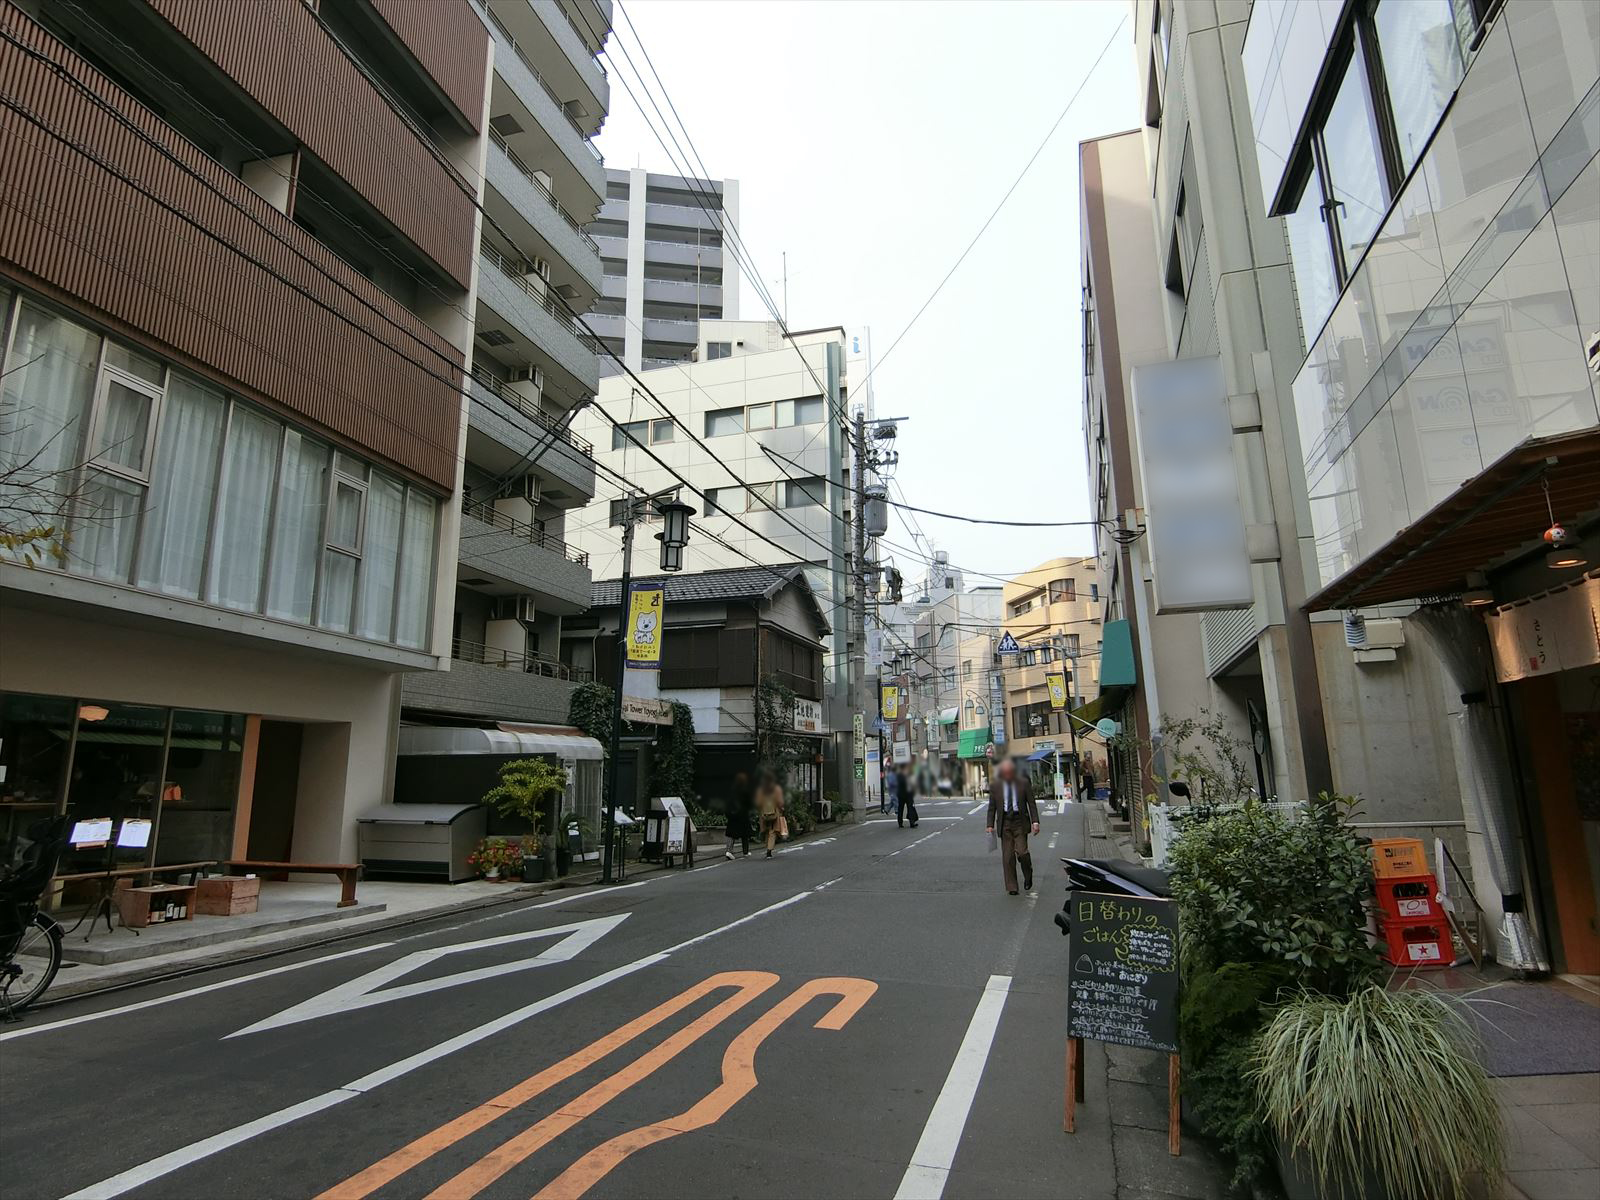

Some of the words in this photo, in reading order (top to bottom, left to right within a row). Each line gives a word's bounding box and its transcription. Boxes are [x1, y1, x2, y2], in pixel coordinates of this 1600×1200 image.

[1533, 619, 1546, 664] さとう
[1079, 902, 1157, 926] 日替わりの
[1083, 927, 1122, 943] ごはん
[1118, 970, 1148, 985] おにぎり
